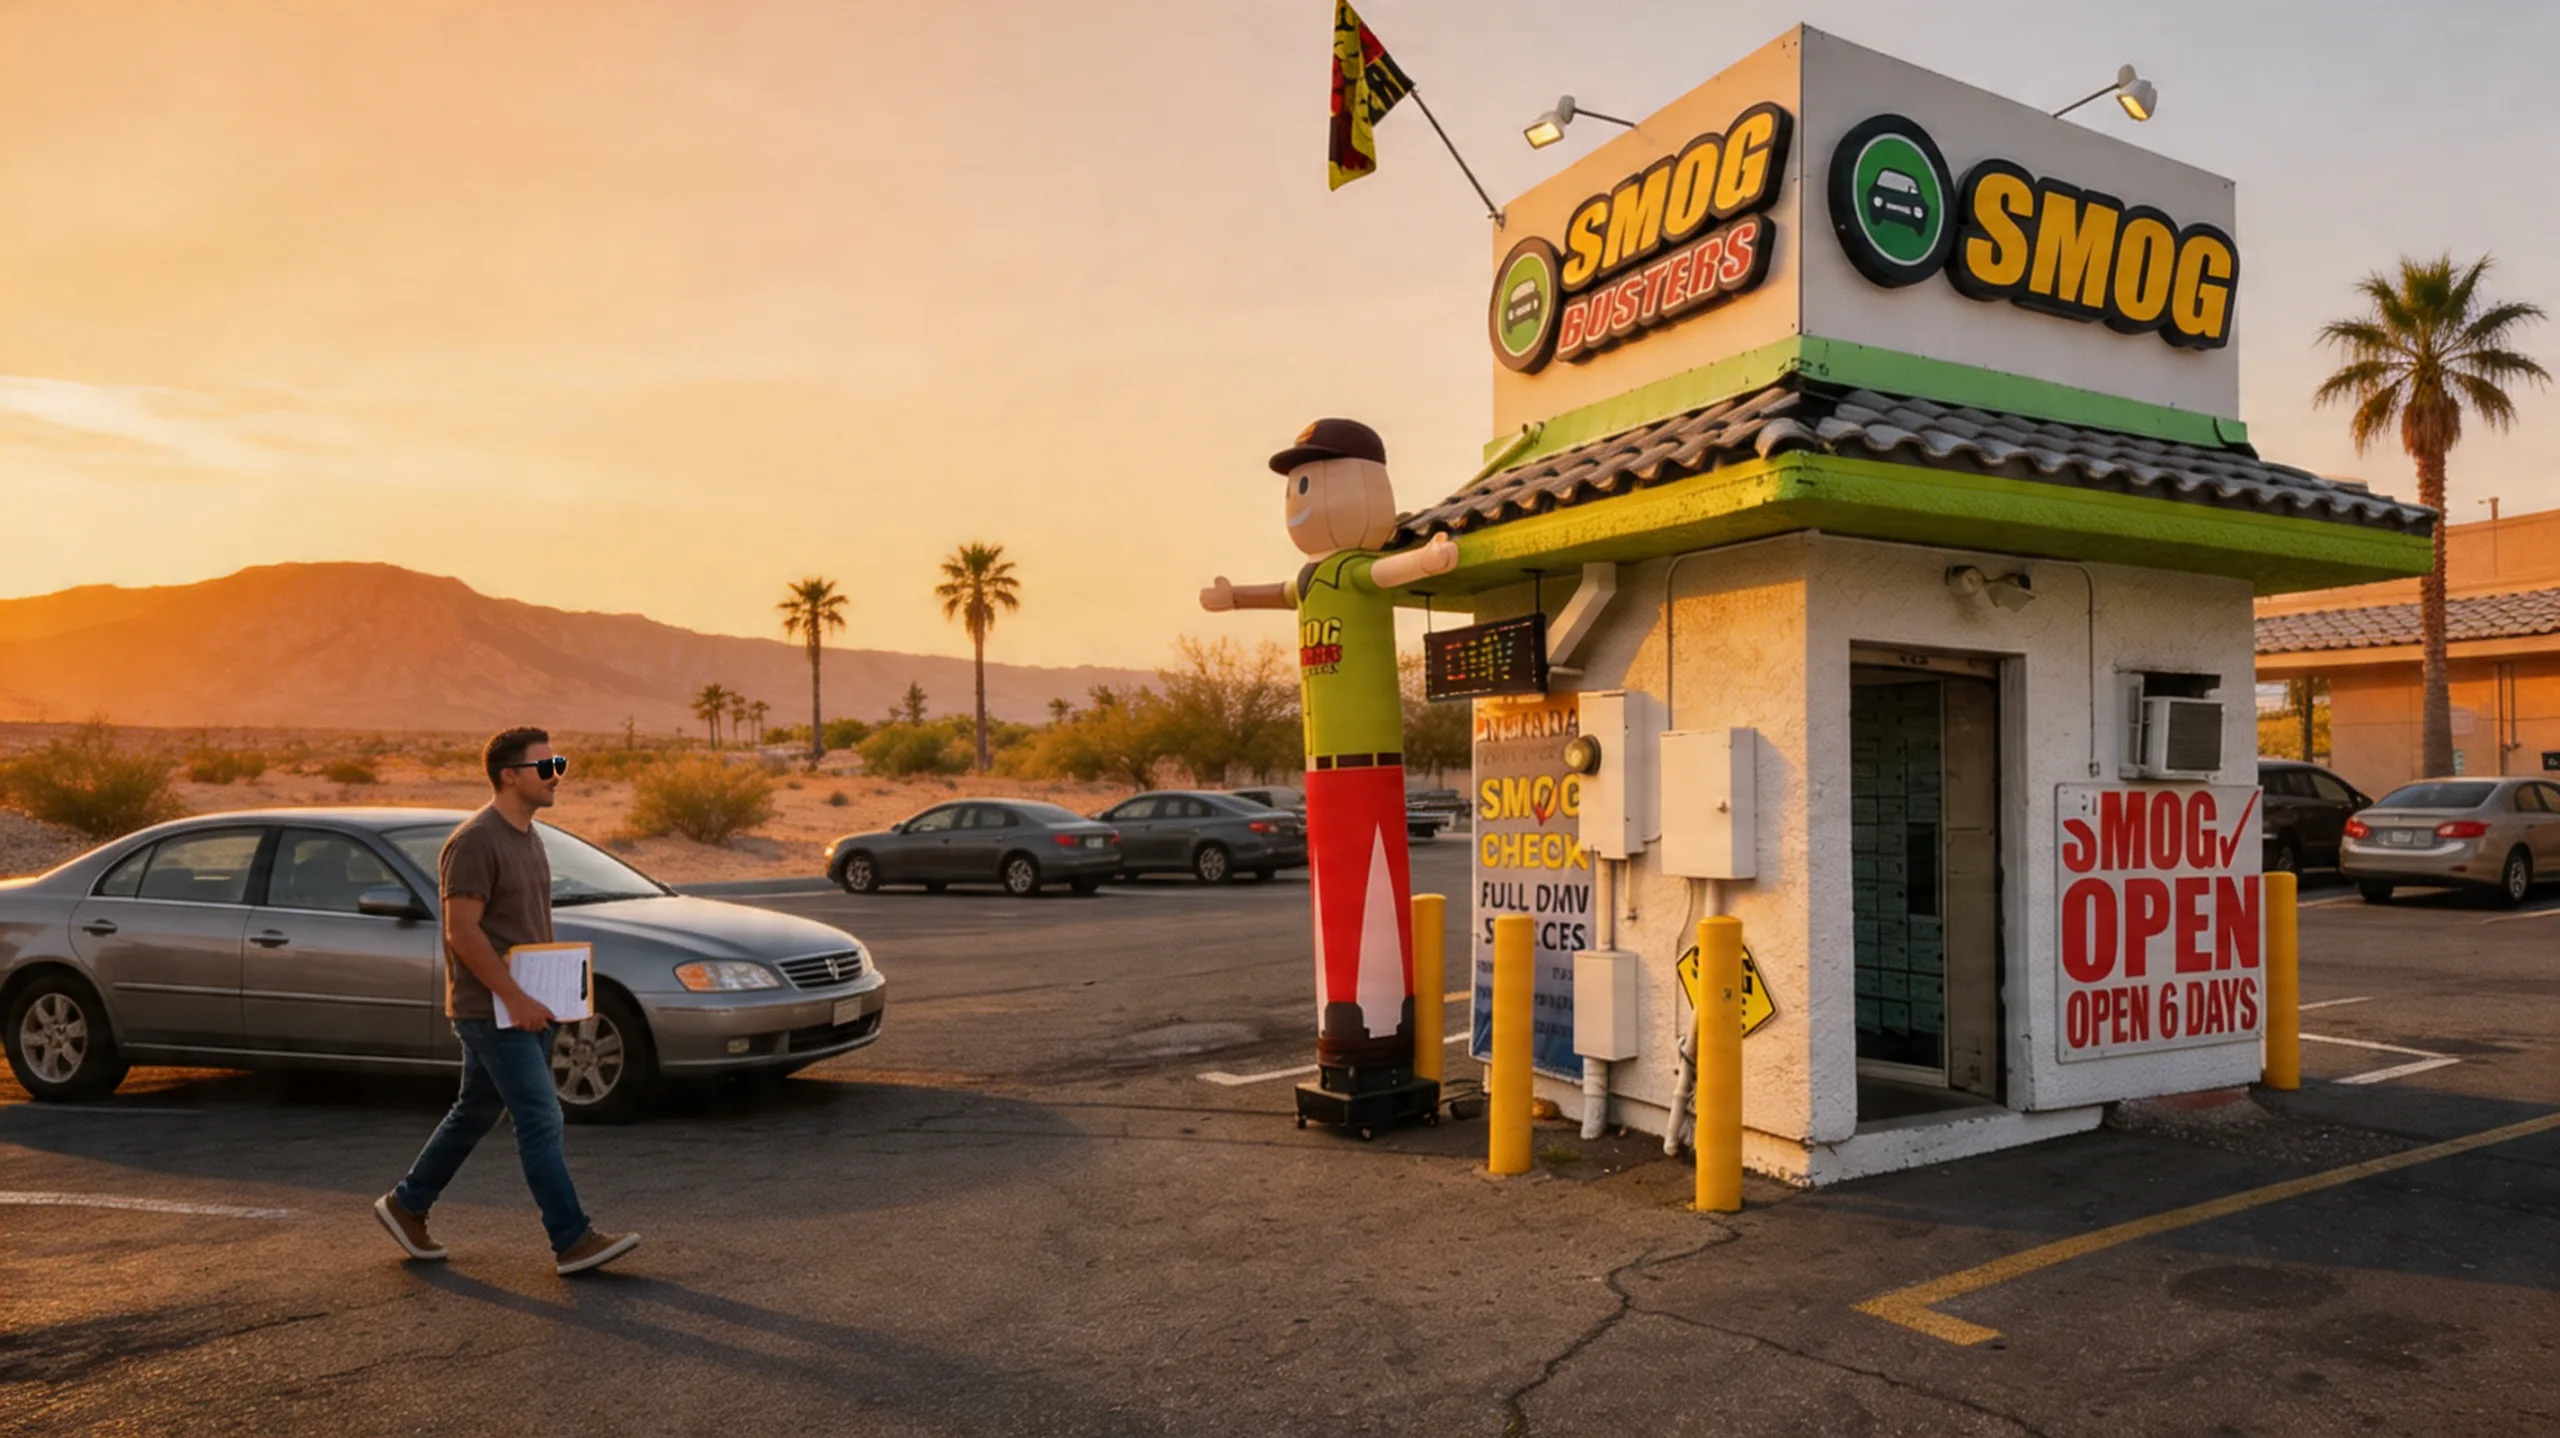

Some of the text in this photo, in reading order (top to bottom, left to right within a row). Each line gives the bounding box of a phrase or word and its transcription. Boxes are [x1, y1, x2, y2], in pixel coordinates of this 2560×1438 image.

[1561, 111, 1774, 285] SMOG
[1557, 221, 1757, 355] BUSTERS
[1966, 172, 2233, 339] SMOG
[1481, 831, 1589, 871] CHECK
[2062, 790, 2218, 873] SMOG
[1481, 881, 1589, 914] FULL DMV
[2062, 875, 2260, 984] OPEN
[2066, 977, 2257, 1049] OPEN 6 DAYS
